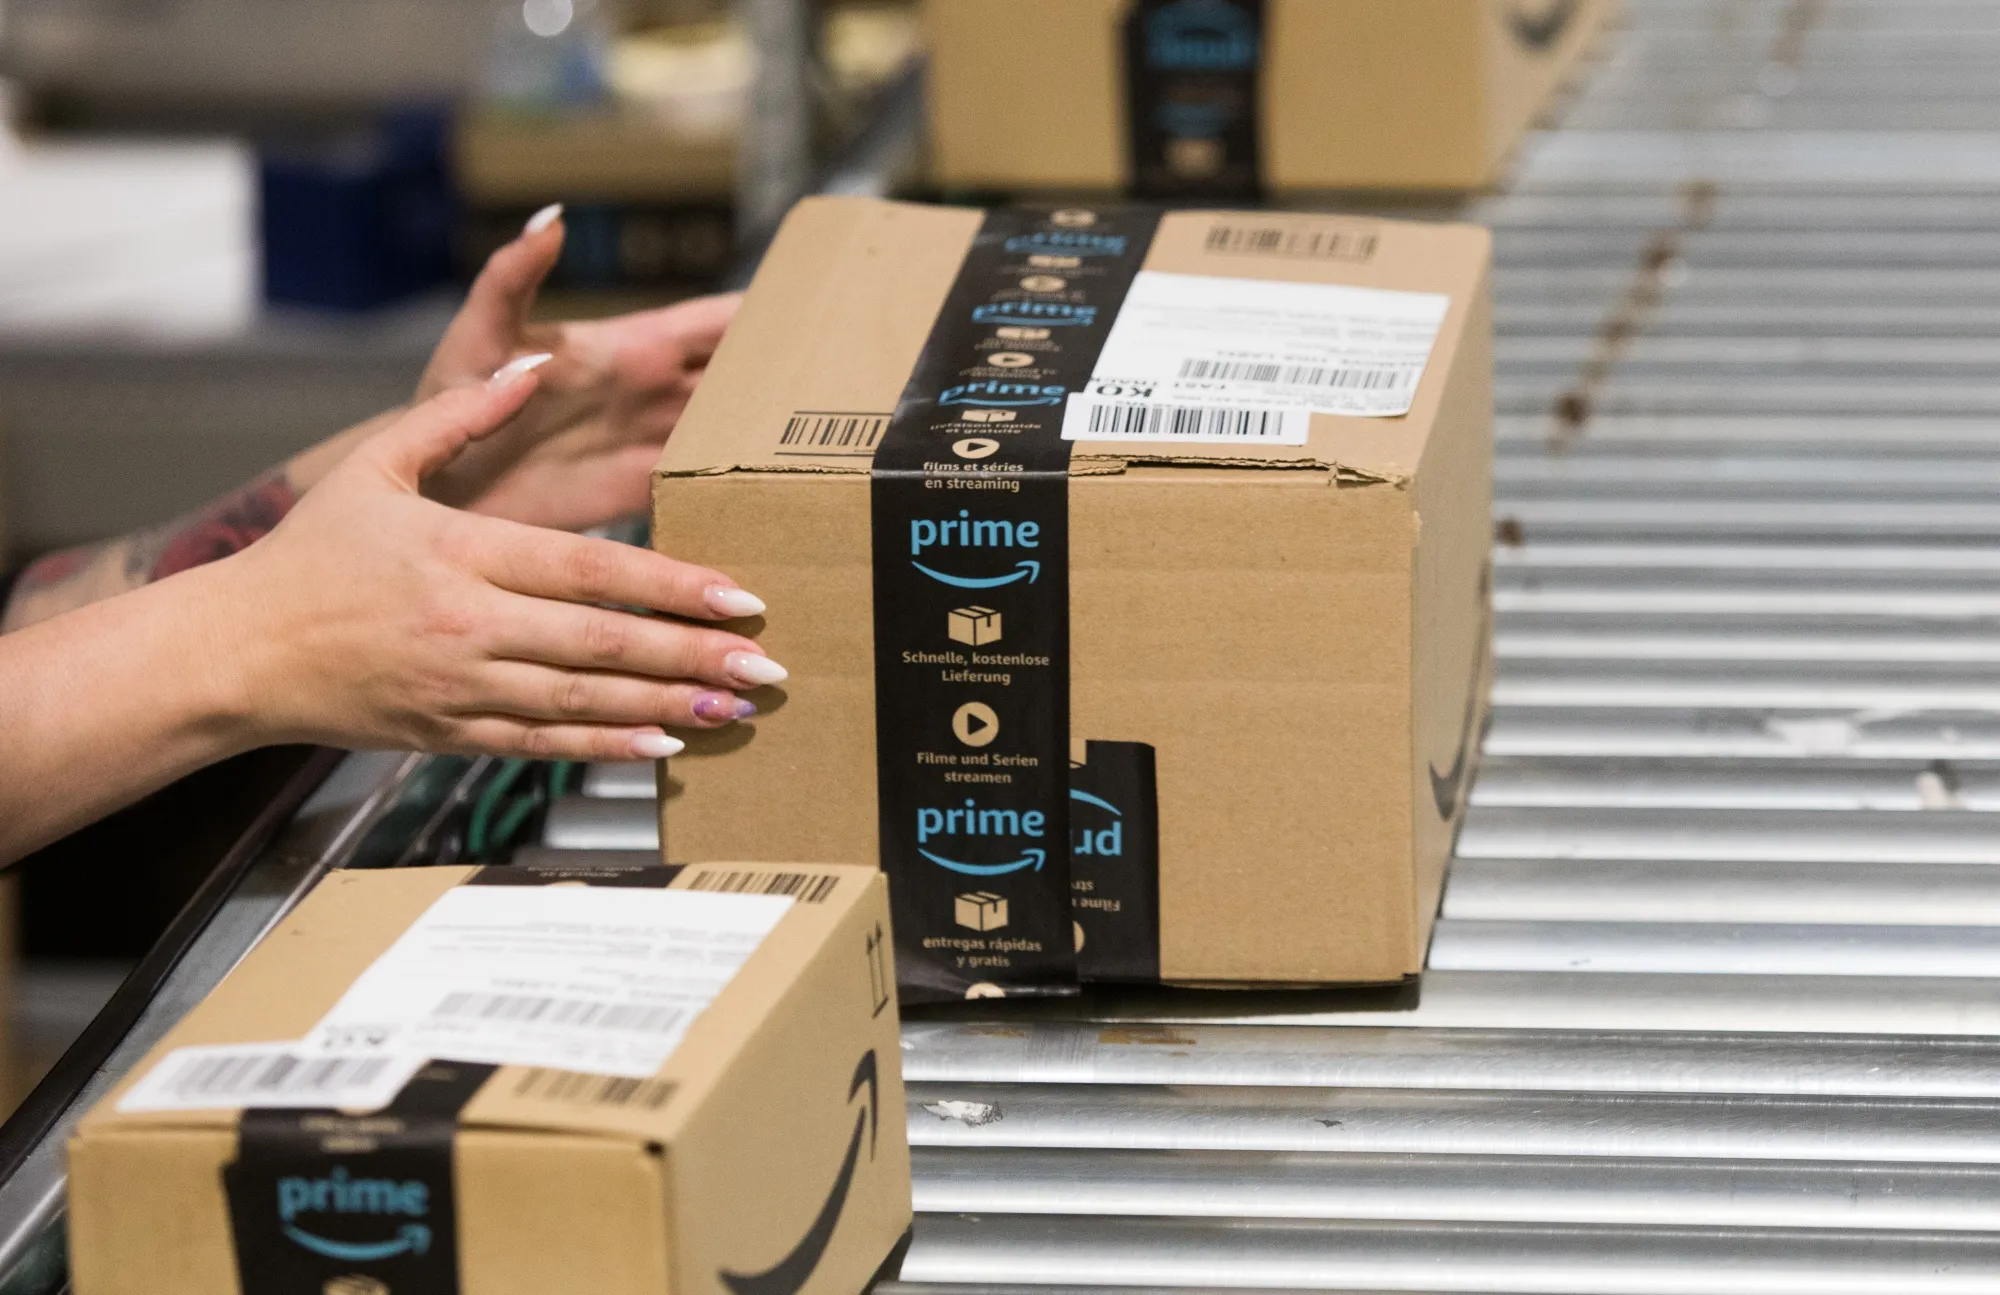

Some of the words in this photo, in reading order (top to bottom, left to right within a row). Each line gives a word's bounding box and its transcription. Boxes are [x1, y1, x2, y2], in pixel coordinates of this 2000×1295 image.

[938, 380, 1066, 405] prime
[1097, 384, 1153, 397] KO
[923, 461, 960, 472] films
[963, 463, 979, 473] et
[982, 462, 1024, 472] séries
[924, 479, 944, 490] en
[946, 476, 1020, 493] streaming
[911, 509, 1040, 555] prime
[902, 650, 968, 666] Schnelle,
[972, 651, 1050, 667] kostenlose
[941, 669, 1011, 686] Lieferung
[916, 751, 957, 765] Filme
[961, 752, 989, 766] und
[992, 753, 1039, 767] Serien
[944, 771, 1012, 784] streamen
[917, 797, 1045, 844] prime
[1080, 898, 1121, 912] Filme
[922, 937, 986, 952] entregas
[989, 937, 1042, 953] rápidas
[956, 957, 967, 970] y
[968, 955, 1011, 969] gratis
[277, 1164, 429, 1221] prime
